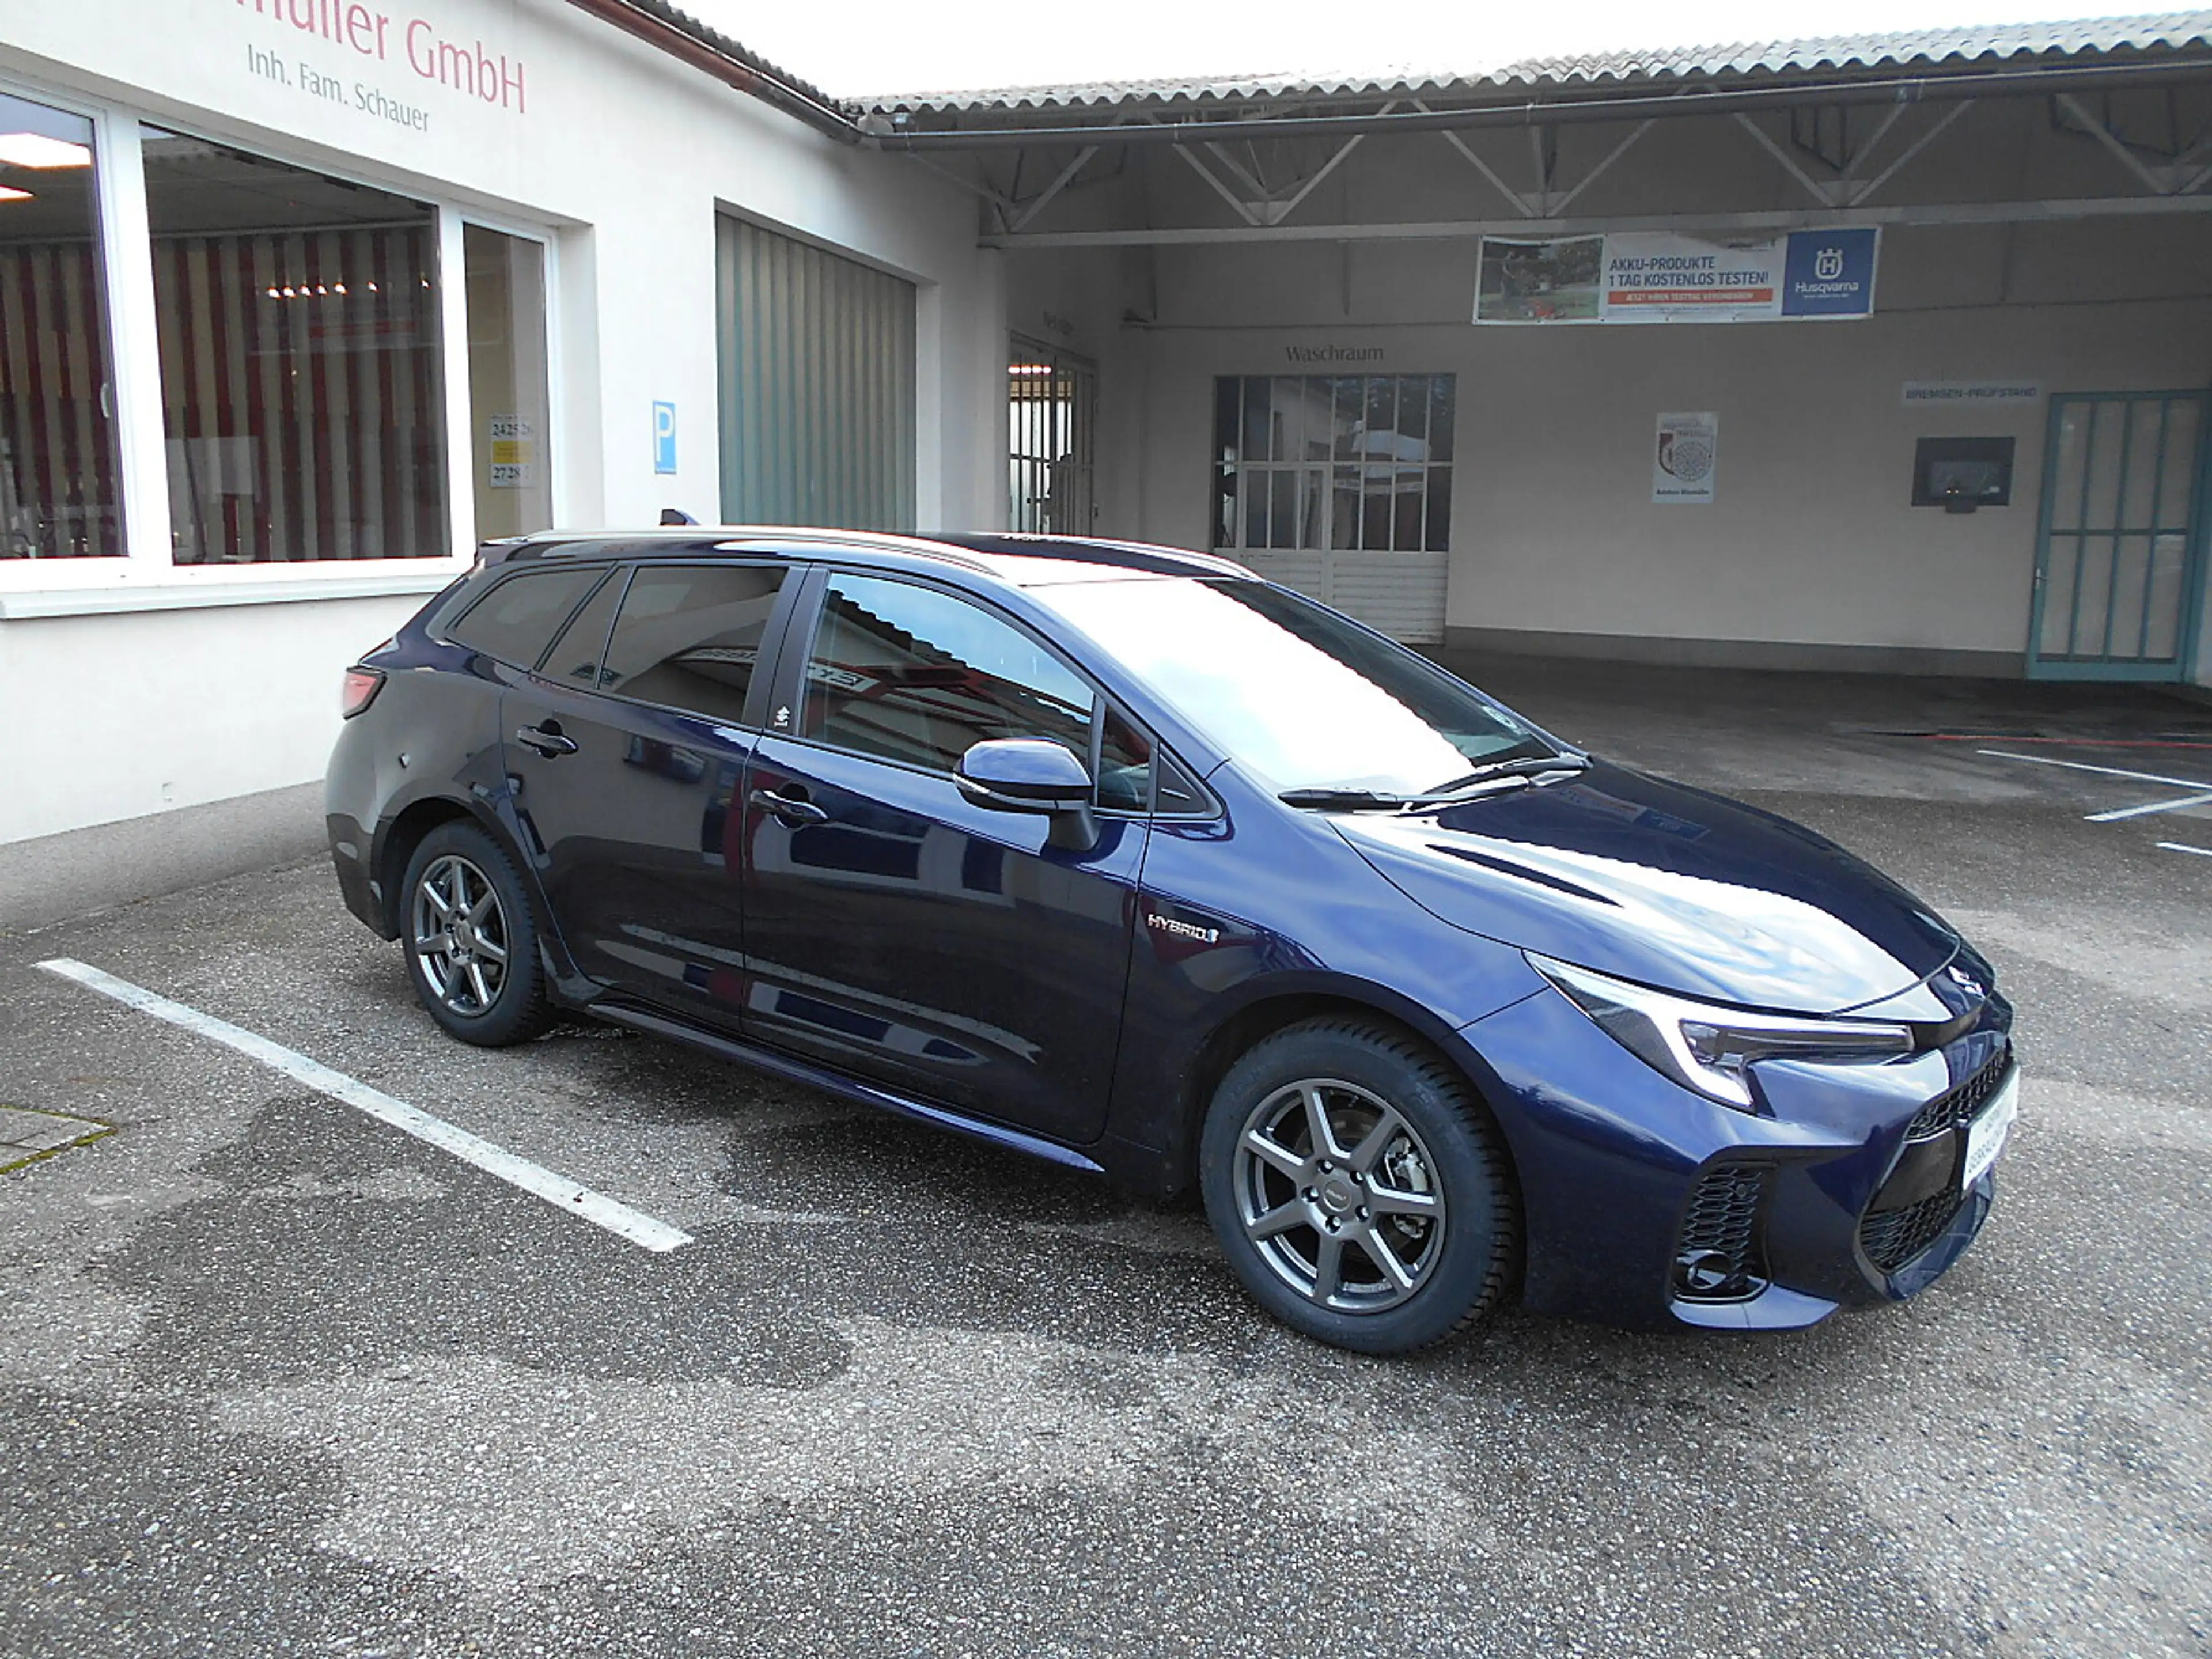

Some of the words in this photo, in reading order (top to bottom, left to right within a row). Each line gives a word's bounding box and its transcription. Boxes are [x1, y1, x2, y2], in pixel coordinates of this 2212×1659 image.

[237, 0, 389, 60] ller
[406, 19, 525, 113] GmbH
[248, 44, 292, 86] Inh.
[300, 63, 347, 105] Fam.
[355, 82, 429, 132] Schauer
[1609, 256, 1715, 271] AKKU-PRODUKTE
[1609, 274, 1615, 286] 1
[1618, 274, 1641, 286] TAG
[1645, 272, 1715, 286] KOSTENLOS
[1718, 271, 1769, 285] TESTEN!
[1795, 281, 1859, 293] Husqvarna
[1286, 345, 1384, 362] Waschraum
[656, 404, 674, 462] P
[1148, 914, 1206, 940] HYBRID
